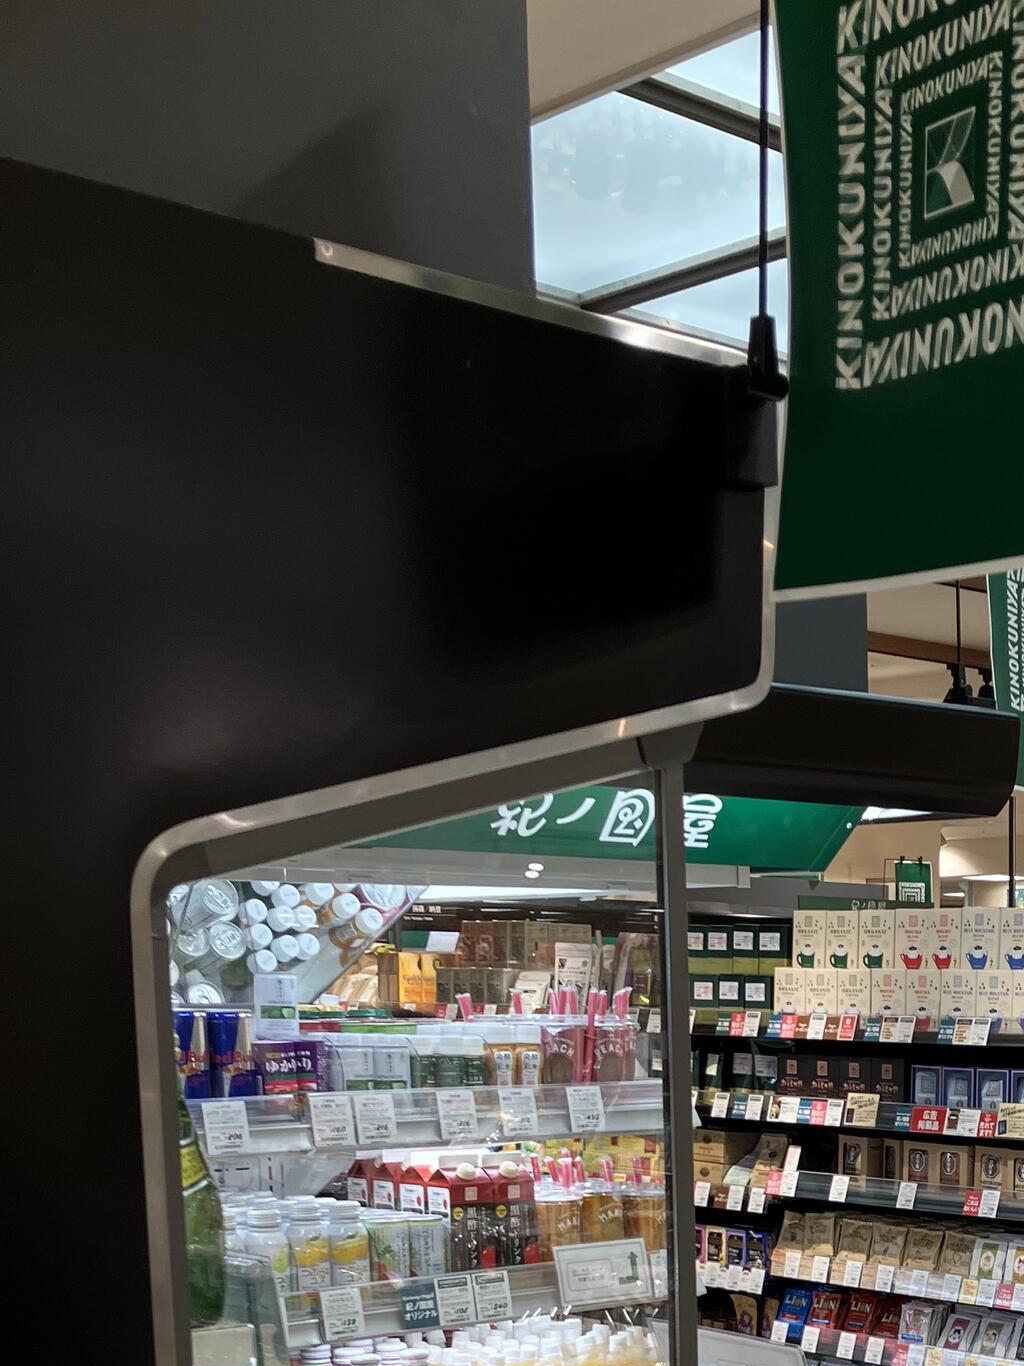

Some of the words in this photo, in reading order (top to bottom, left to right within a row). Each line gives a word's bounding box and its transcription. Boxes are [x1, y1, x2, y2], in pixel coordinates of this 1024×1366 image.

[835, 54, 866, 390] KINOKUNIYA
[871, 89, 893, 321] KINOKUNIYA
[1006, 577, 1020, 710] KINOKUNIYA
